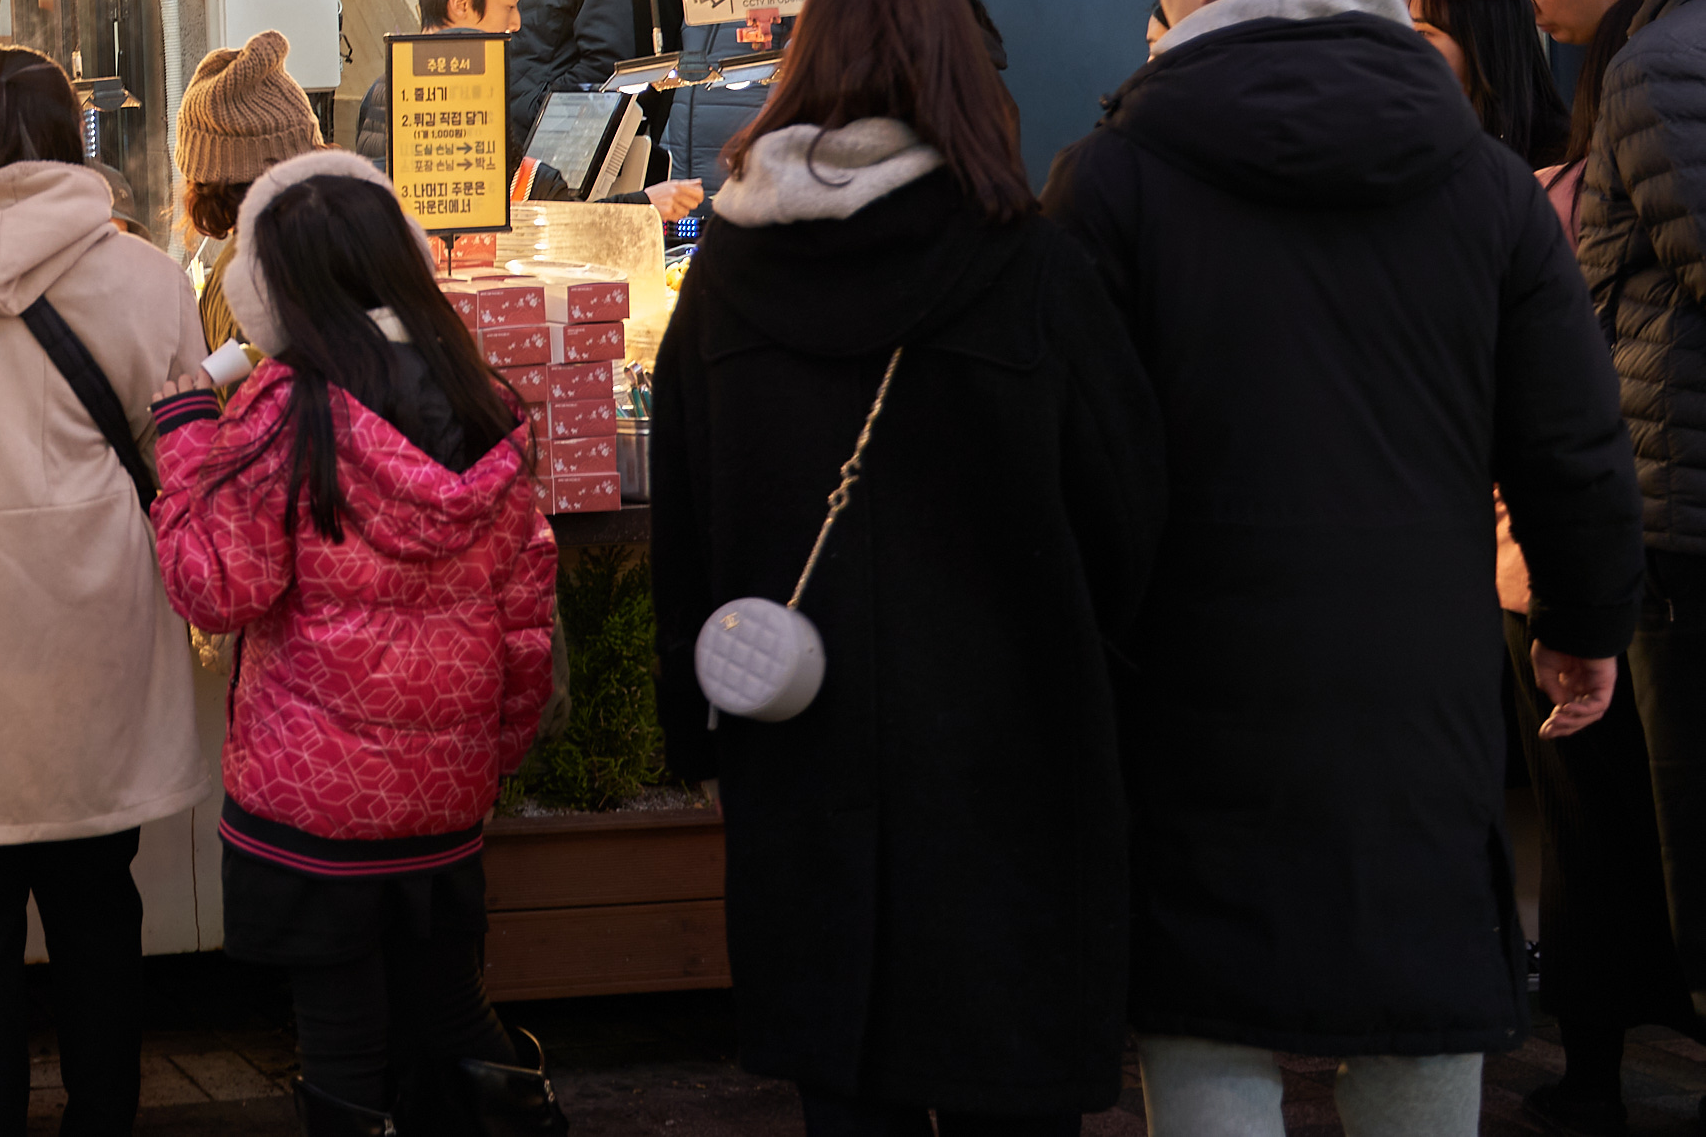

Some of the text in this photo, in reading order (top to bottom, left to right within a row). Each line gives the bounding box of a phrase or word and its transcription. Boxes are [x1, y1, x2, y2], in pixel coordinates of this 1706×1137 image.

[427, 57, 470, 73] 주문 순서
[414, 86, 448, 102] 줄서기
[414, 112, 436, 127] 튀김
[440, 112, 461, 127] 직접
[466, 111, 488, 126] 담기
[436, 144, 454, 156] 손님
[475, 140, 496, 154] 접시
[436, 160, 454, 172] 손님
[475, 157, 496, 171] 박스
[413, 183, 448, 198] 나머지
[451, 181, 485, 196] 주문은
[414, 199, 471, 215] 카운터에서
